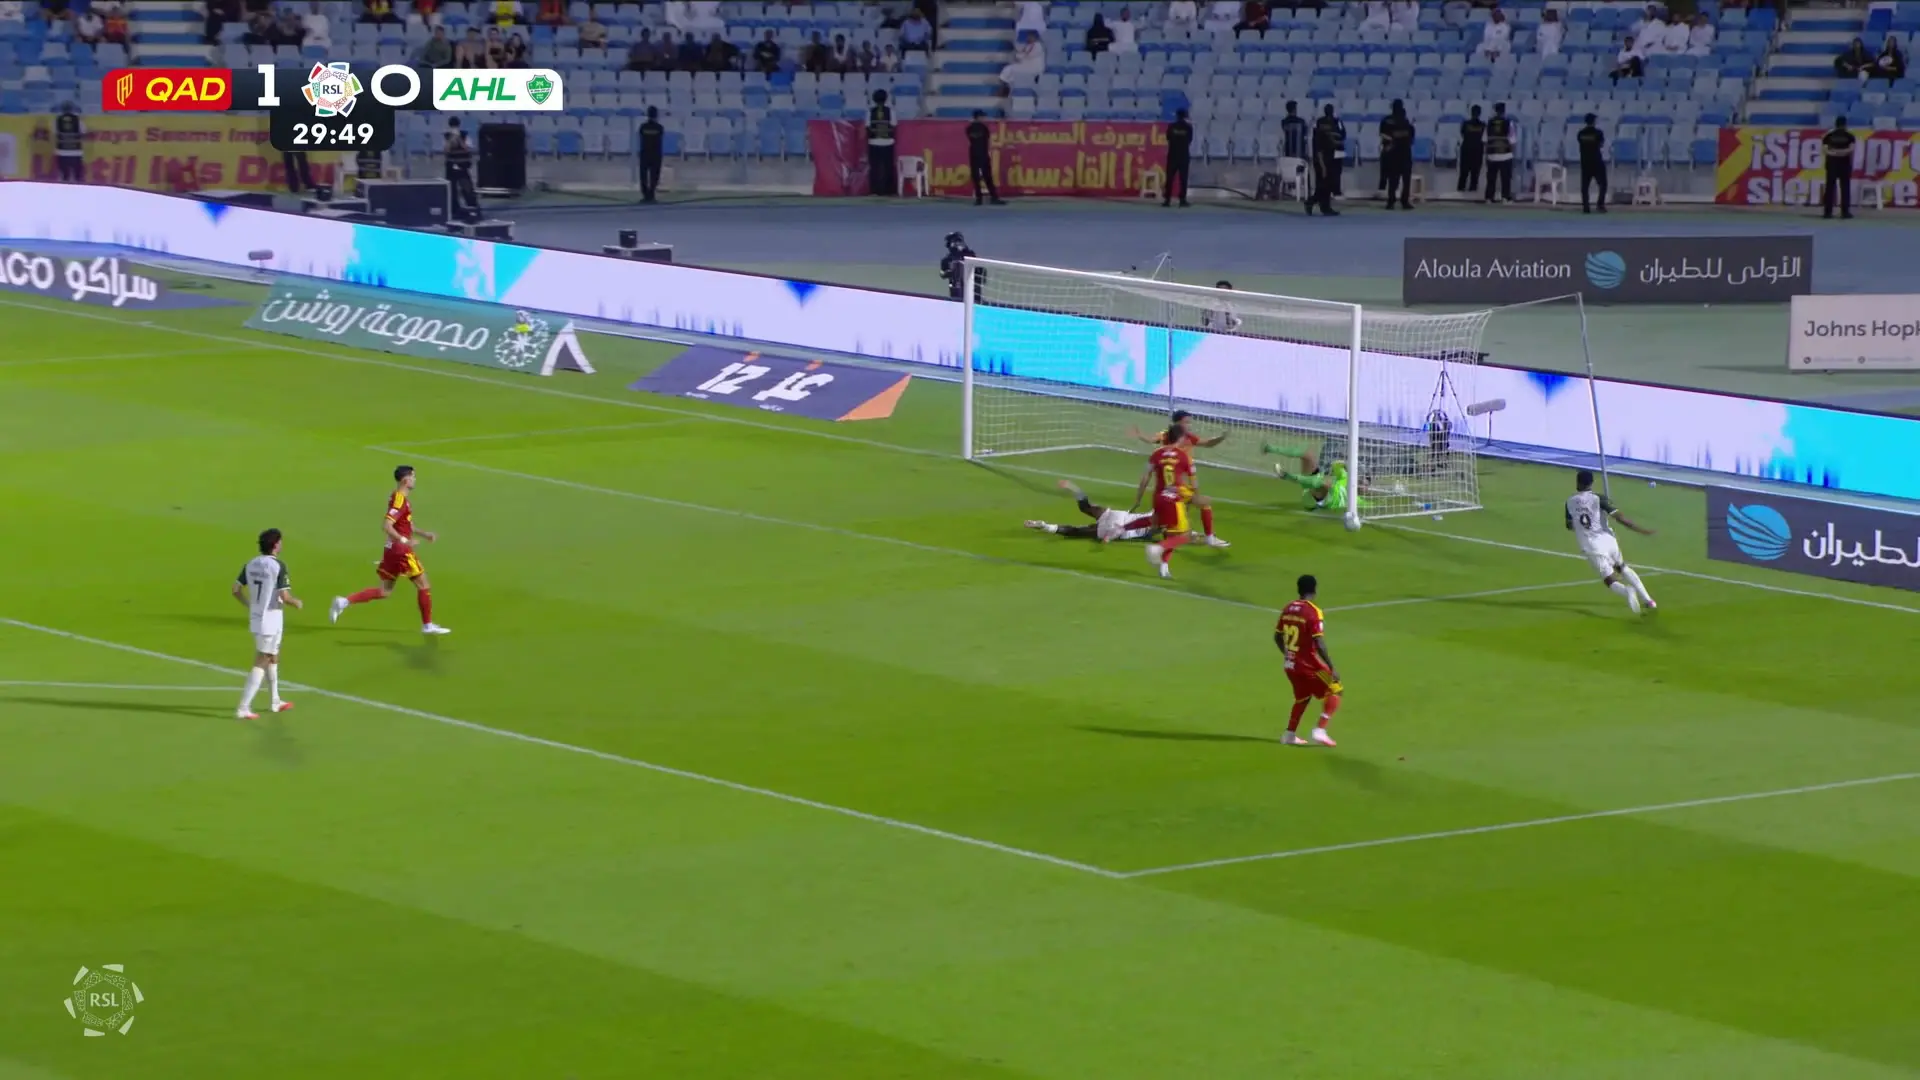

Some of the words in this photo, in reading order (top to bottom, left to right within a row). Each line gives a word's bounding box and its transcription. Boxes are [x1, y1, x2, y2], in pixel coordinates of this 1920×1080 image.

[145, 127, 222, 144] Seems
[31, 153, 136, 184] Util
[0, 251, 54, 290] CO
[1414, 258, 1482, 279] Aloula
[1486, 257, 1572, 279] Aviation
[1639, 256, 1722, 285] للطيران
[1727, 255, 1801, 285] الأولى
[261, 288, 358, 335] روشن
[359, 303, 490, 351] مجموعة
[1803, 320, 1867, 338] Johns
[1580, 513, 1592, 530] 9
[253, 579, 263, 605] 7
